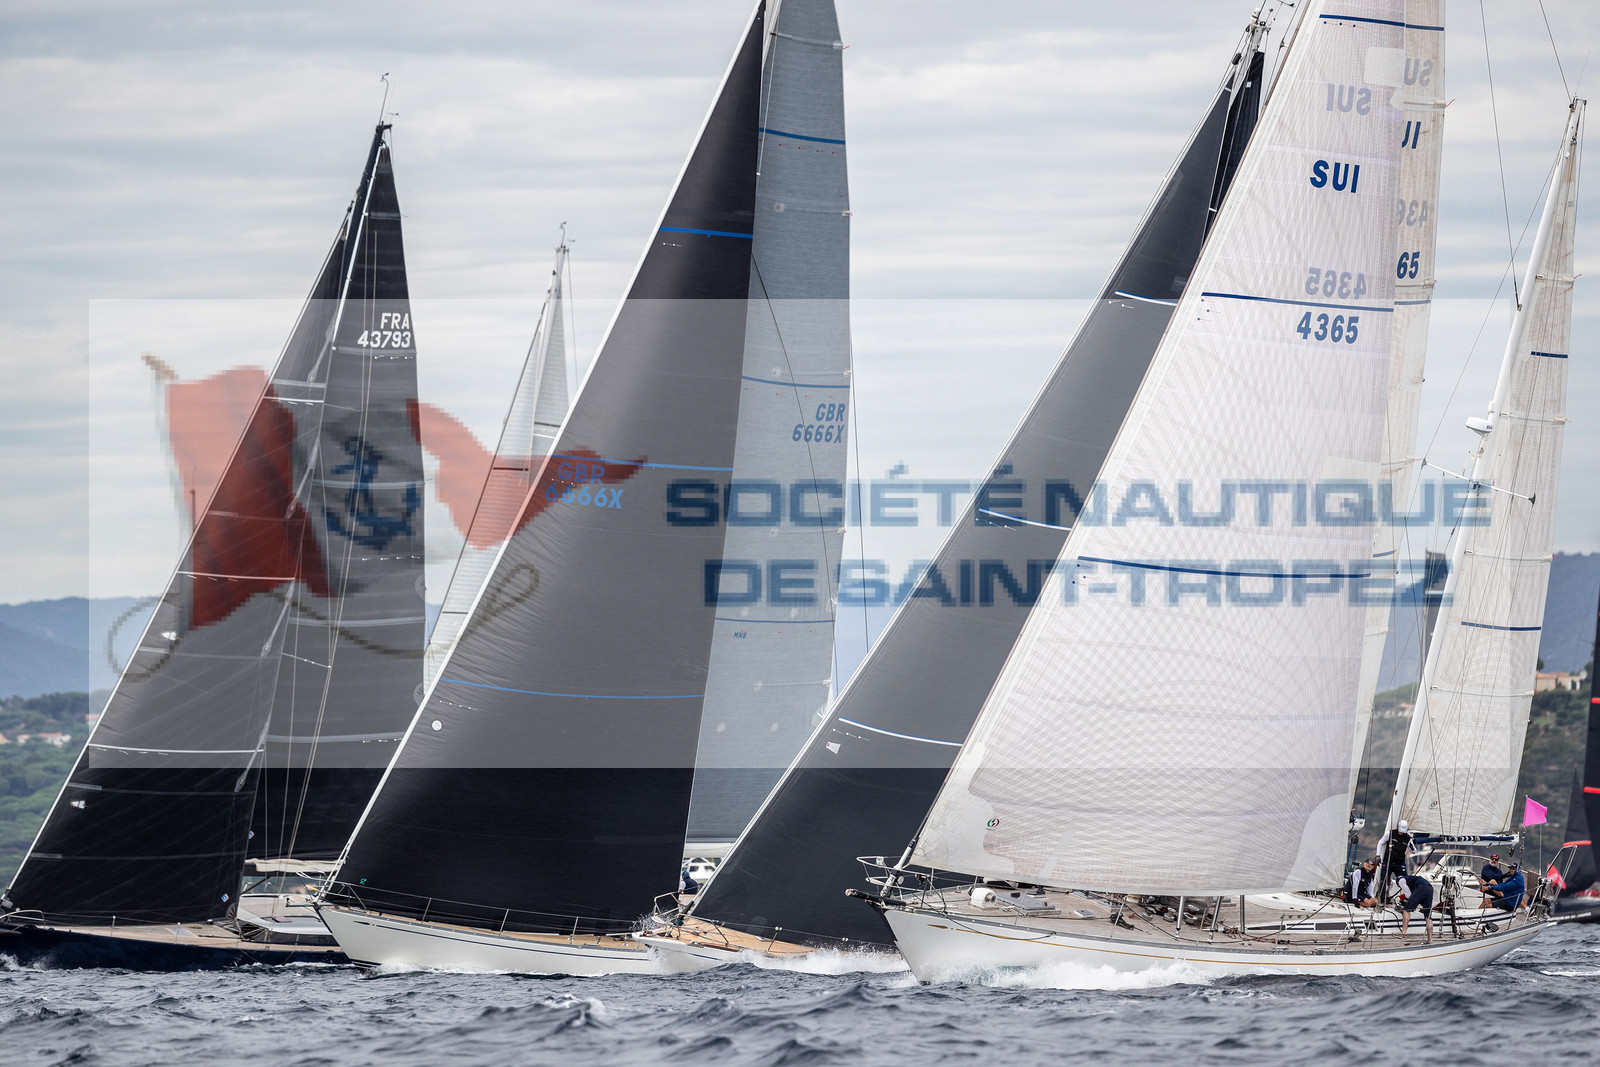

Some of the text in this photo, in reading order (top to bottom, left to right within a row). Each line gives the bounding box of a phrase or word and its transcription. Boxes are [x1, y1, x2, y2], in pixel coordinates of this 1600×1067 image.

[1310, 159, 1360, 194] SUI
[1396, 251, 1421, 280] 65
[380, 312, 410, 330] FRA
[1296, 311, 1360, 345] 4365
[357, 330, 411, 349] 43793
[815, 403, 846, 422] GBR
[792, 424, 846, 444] 6666X
[558, 461, 606, 486] GBR
[544, 482, 624, 510] 6666X
